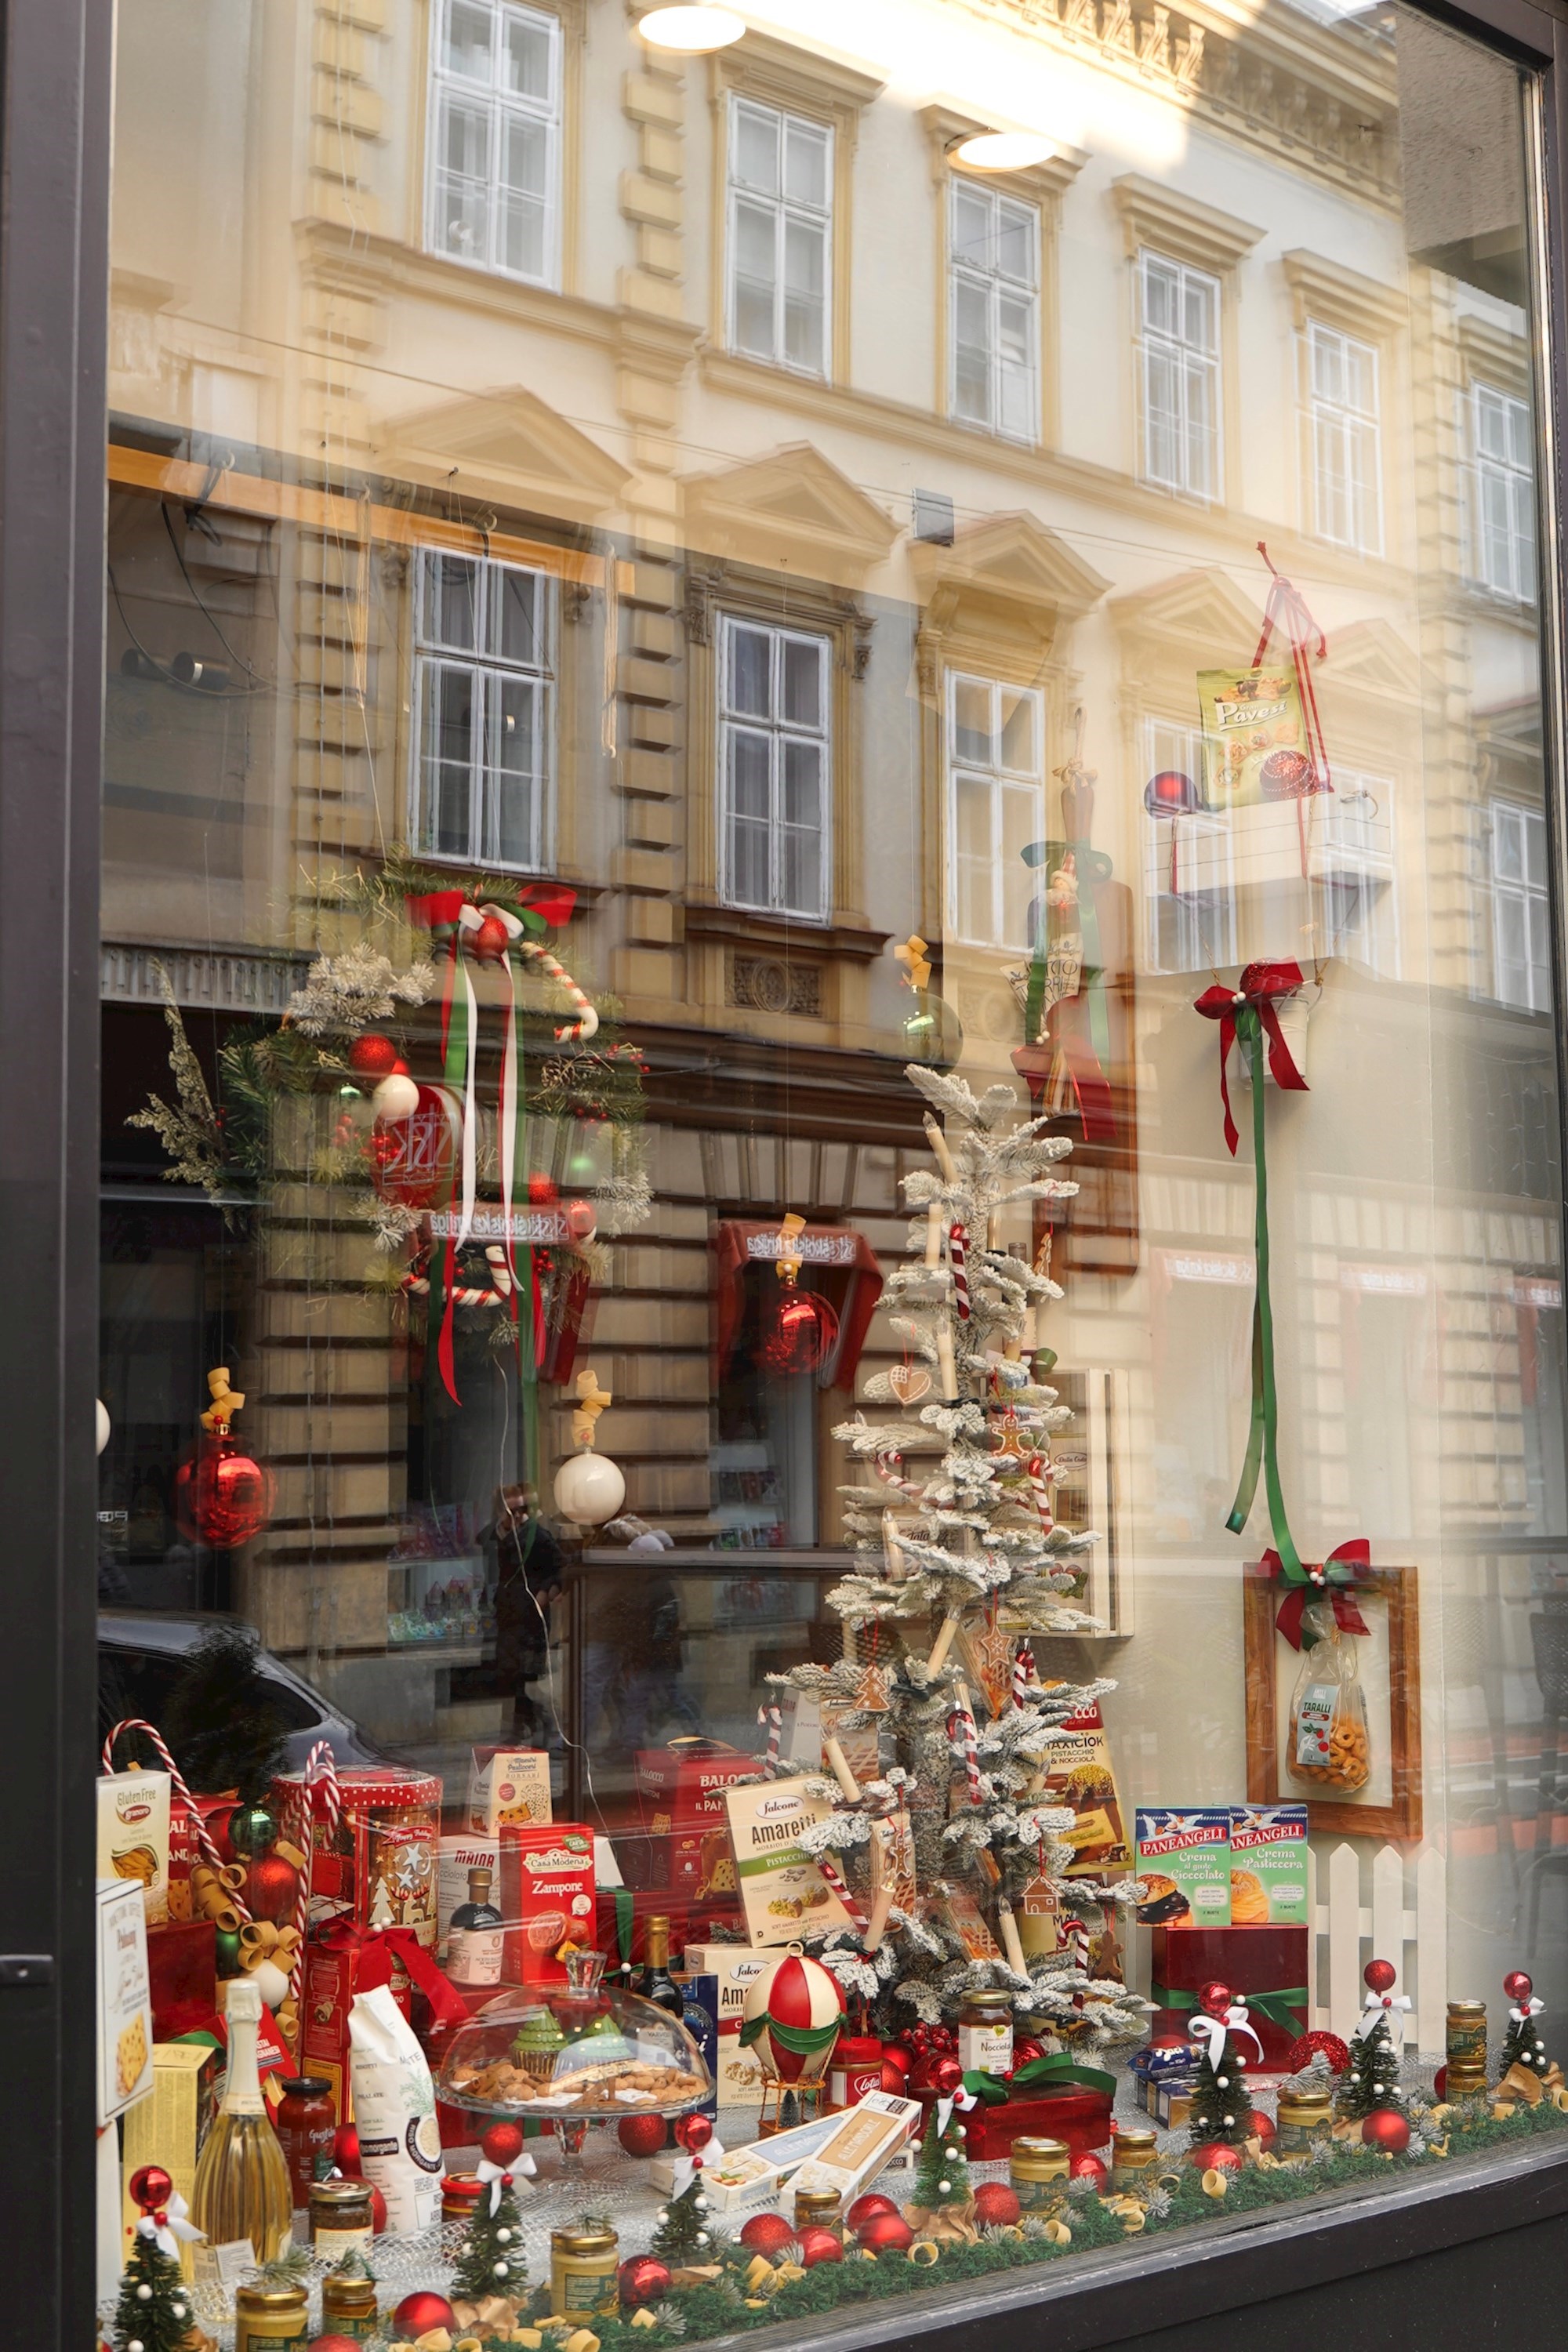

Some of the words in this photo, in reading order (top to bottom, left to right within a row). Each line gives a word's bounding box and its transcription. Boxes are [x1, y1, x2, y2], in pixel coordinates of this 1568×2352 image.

[1215, 701, 1287, 725] Pavesi
[1074, 1707, 1098, 1719] CCO
[1304, 1702, 1331, 1713] TARALLI
[118, 1790, 141, 1806] Gluten
[141, 1788, 156, 1802] Free
[764, 1800, 800, 1817] falcone
[1142, 1828, 1223, 1855] PANEANGELI
[1231, 1825, 1300, 1850] ANEANGELI
[455, 1849, 495, 1868] MAINA
[1179, 1853, 1217, 1862] Crema
[1256, 1848, 1296, 1859] Crema
[552, 1857, 584, 1866] Modena
[1243, 1857, 1304, 1870] Pasticcera
[439, 1869, 467, 1880] cciolato
[1171, 1869, 1225, 1880] Cioccolato
[532, 1880, 583, 1896] Zampone
[1053, 1914, 1074, 1926] MA
[981, 2042, 1011, 2052] Nocciola
[860, 2077, 880, 2091] Lotus
